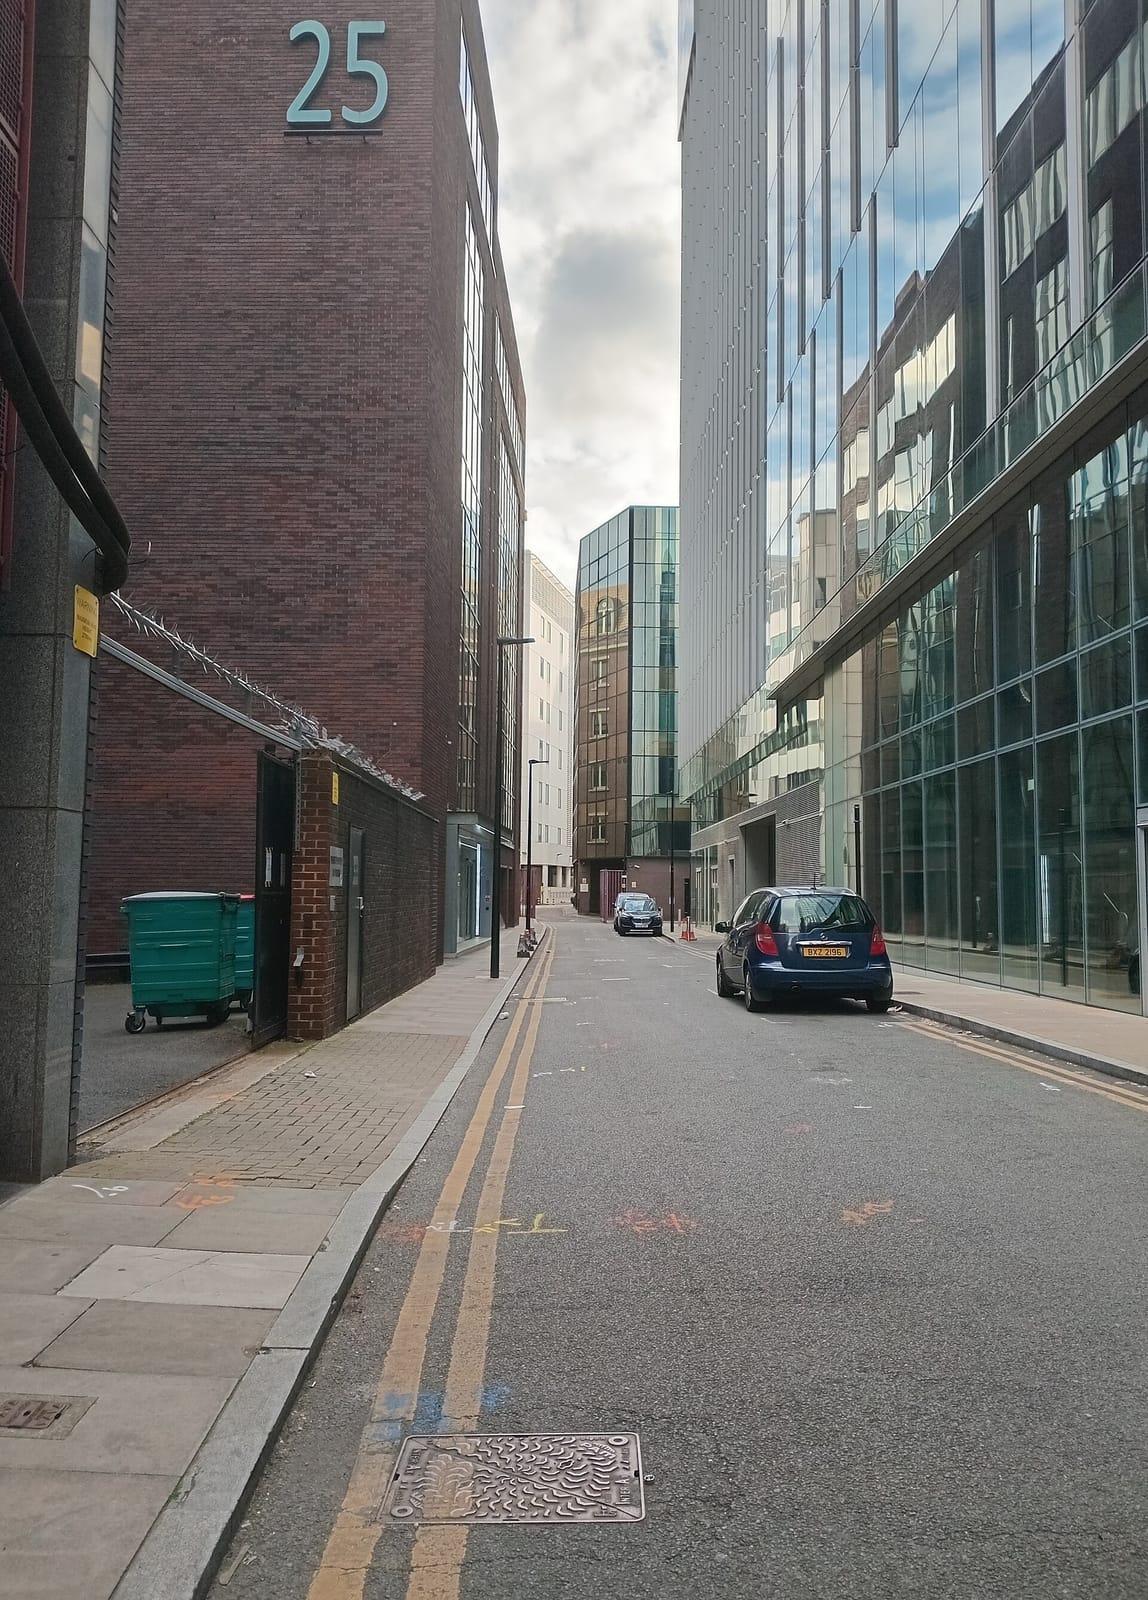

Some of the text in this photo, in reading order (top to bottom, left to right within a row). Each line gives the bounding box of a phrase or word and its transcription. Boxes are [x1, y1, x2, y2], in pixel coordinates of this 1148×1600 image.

[286, 19, 389, 124] 25
[807, 948, 842, 956] BXZ 2196
